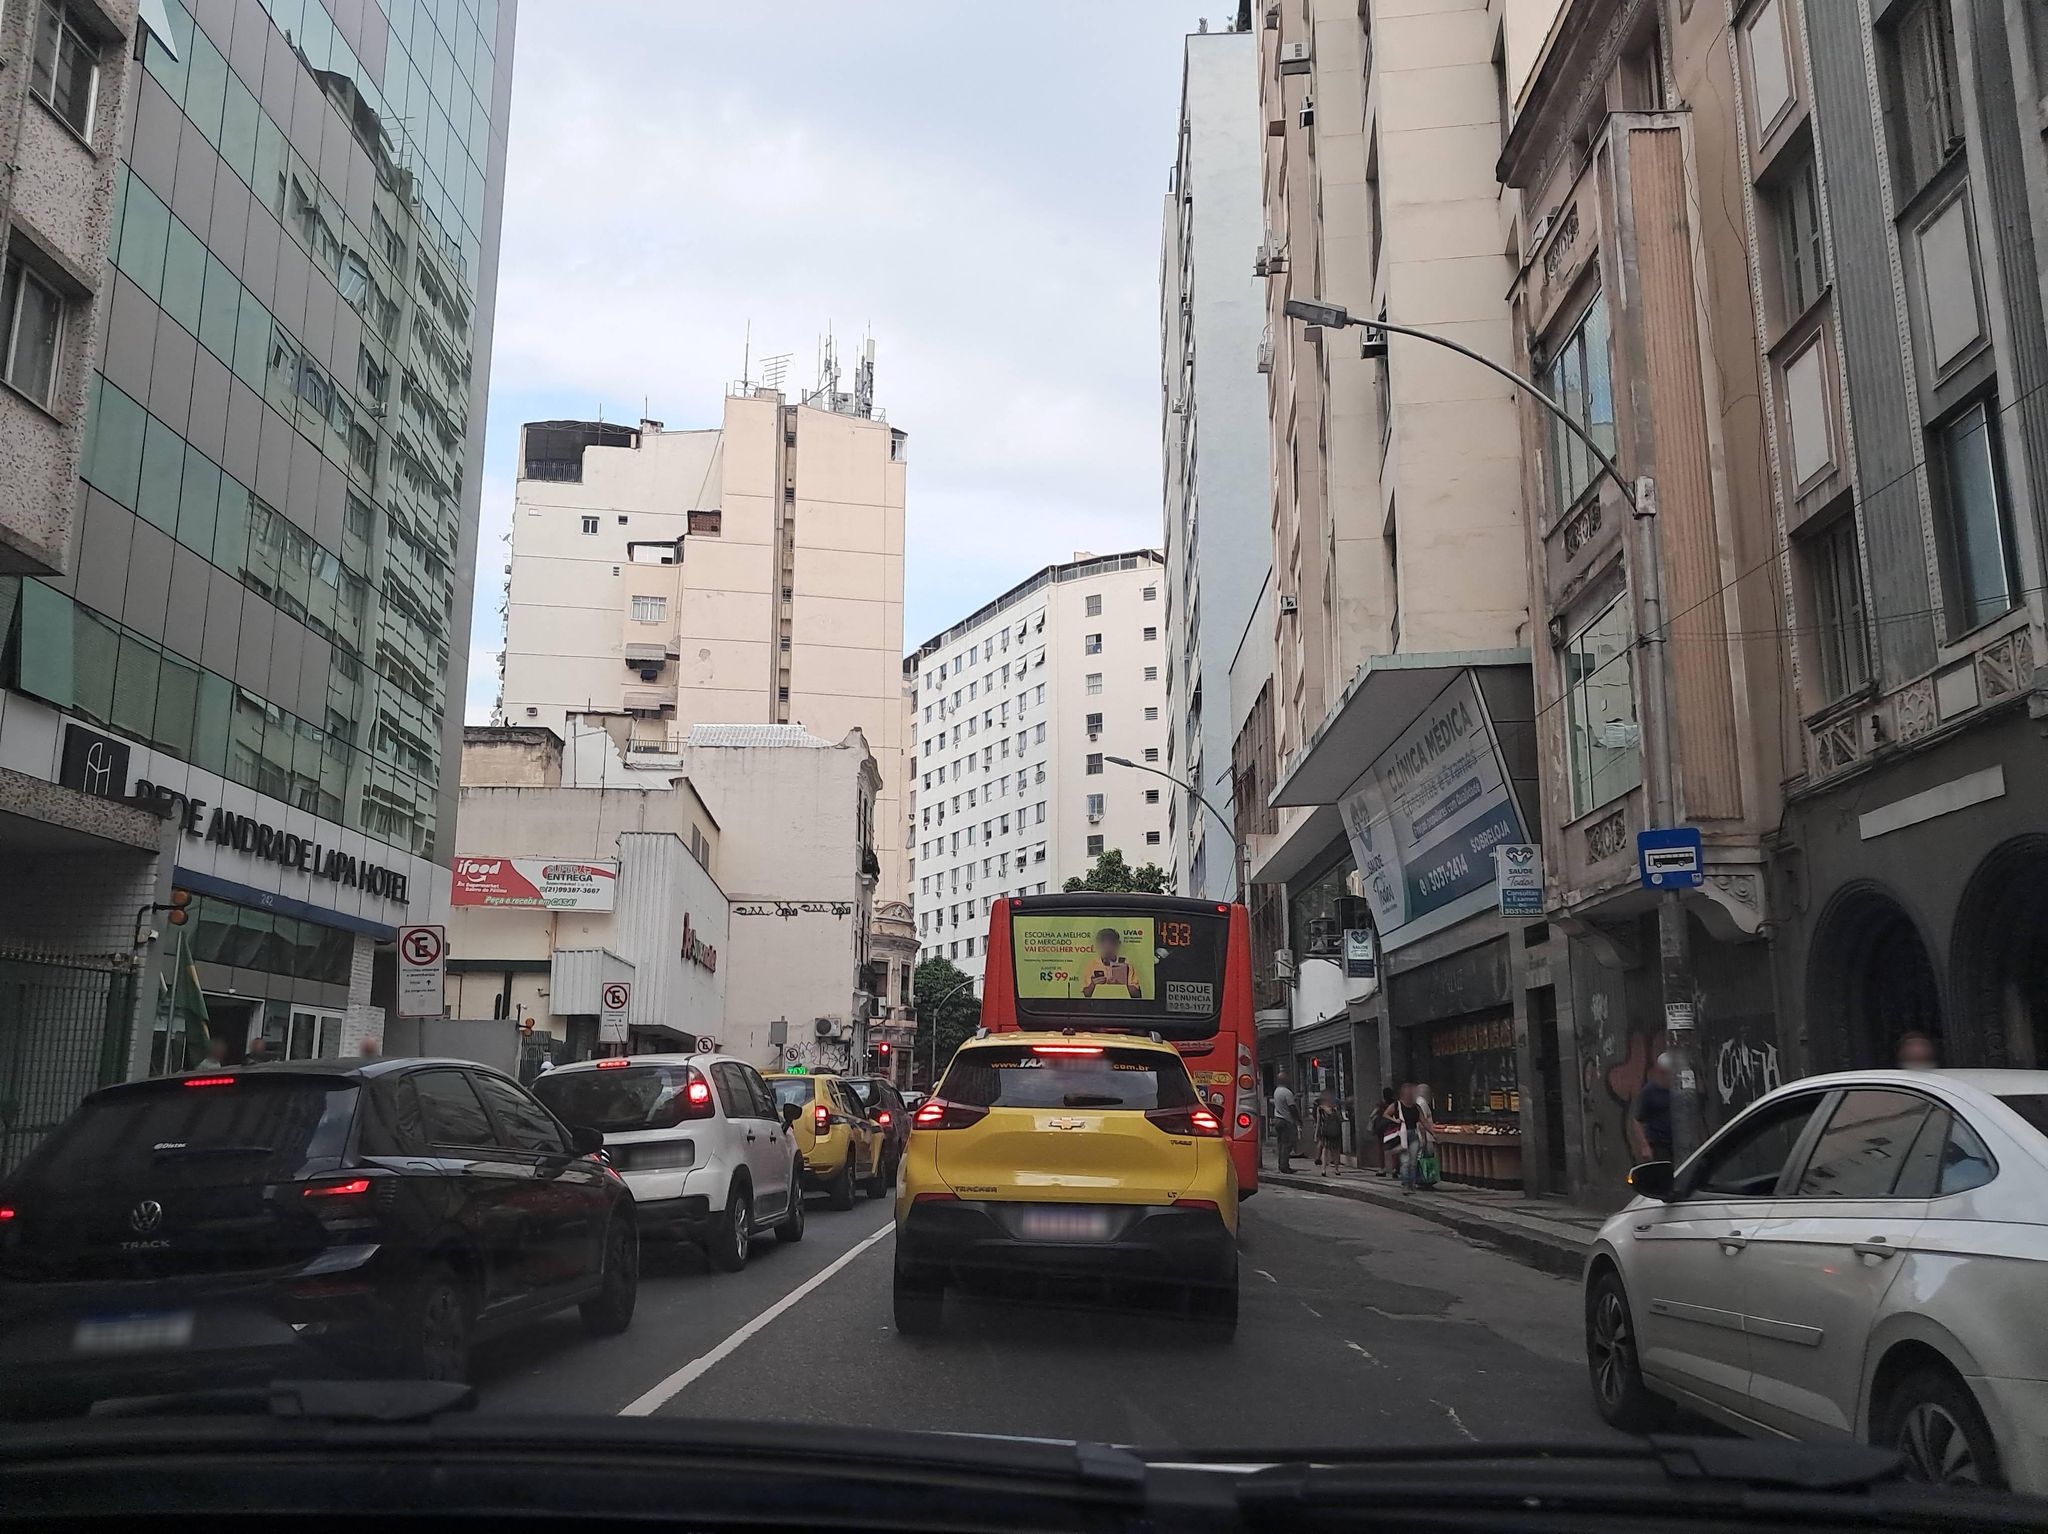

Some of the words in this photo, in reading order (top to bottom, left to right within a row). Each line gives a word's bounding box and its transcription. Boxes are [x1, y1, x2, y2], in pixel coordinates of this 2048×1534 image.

[1387, 741, 1428, 793] CLÍNICA
[1430, 700, 1474, 761] MÉDICA
[1470, 819, 1512, 854] SOBRELOJA
[205, 807, 314, 873] ANDRADE
[313, 843, 358, 888] LAPA
[358, 859, 410, 905] HOTEL
[457, 859, 502, 876] ifood
[1428, 853, 1469, 892] 3031-2414
[547, 874, 593, 882] ENTREGA
[260, 894, 274, 907] 242
[485, 896, 504, 905] Peça
[550, 898, 578, 907] CASA!
[1157, 922, 1191, 946] 433
[1040, 971, 1053, 982] R$
[1054, 971, 1068, 981] 99
[1168, 984, 1211, 993] DISQUE
[1168, 994, 1211, 1002] DENUNCIA
[787, 1067, 806, 1075] TAXI
[120, 1239, 171, 1250] TRACK
